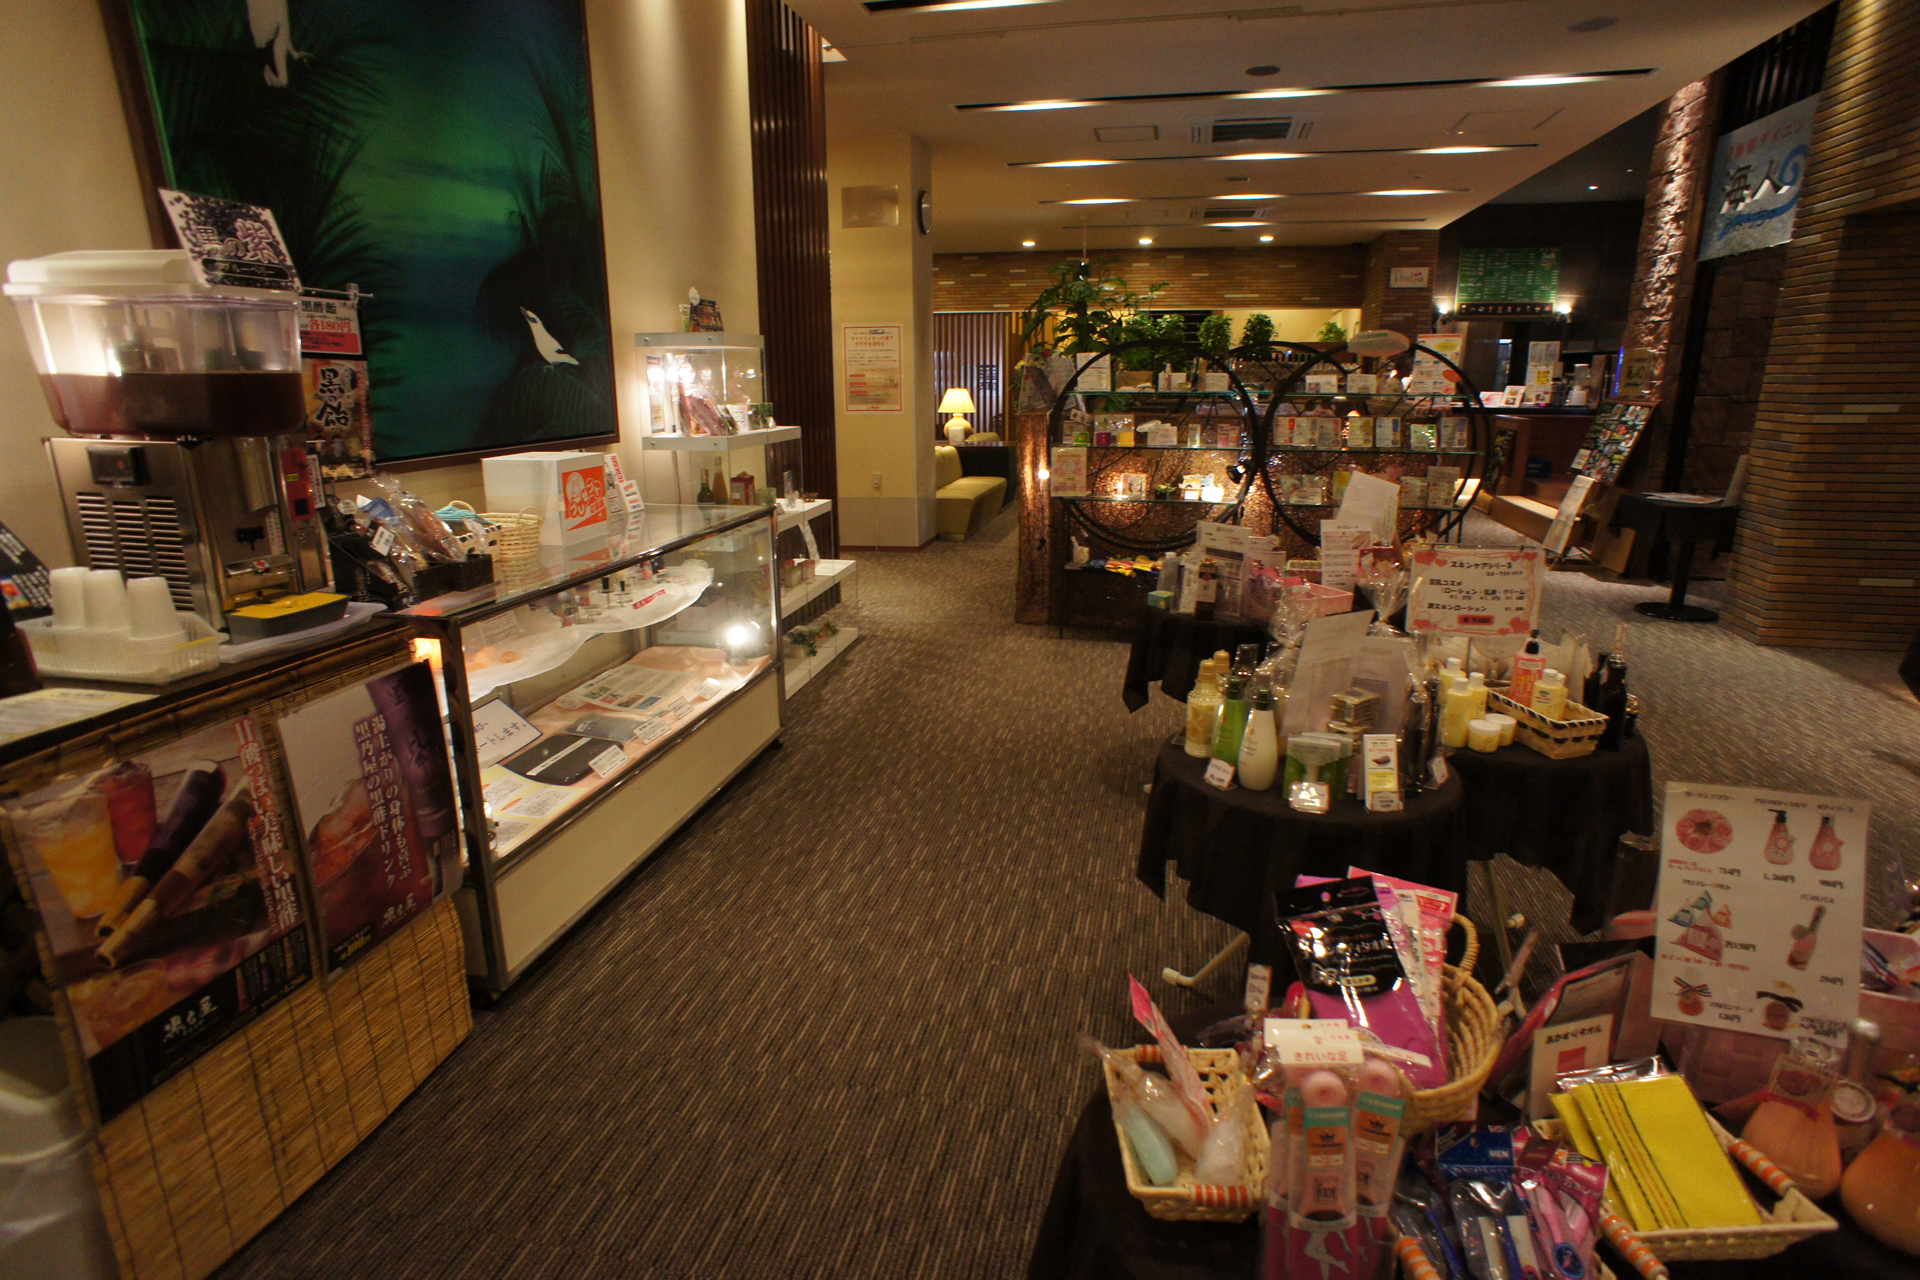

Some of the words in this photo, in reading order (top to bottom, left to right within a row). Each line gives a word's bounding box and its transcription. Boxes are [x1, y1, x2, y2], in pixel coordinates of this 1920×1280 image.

[316, 368, 349, 427] 黒の飴
[235, 719, 299, 931] 甘酸っぱい美味しい黒酢
[355, 721, 396, 889] 黒乃屋の黒酢ドリンク
[371, 713, 412, 881] 湯上がりの身体も喜ぶ
